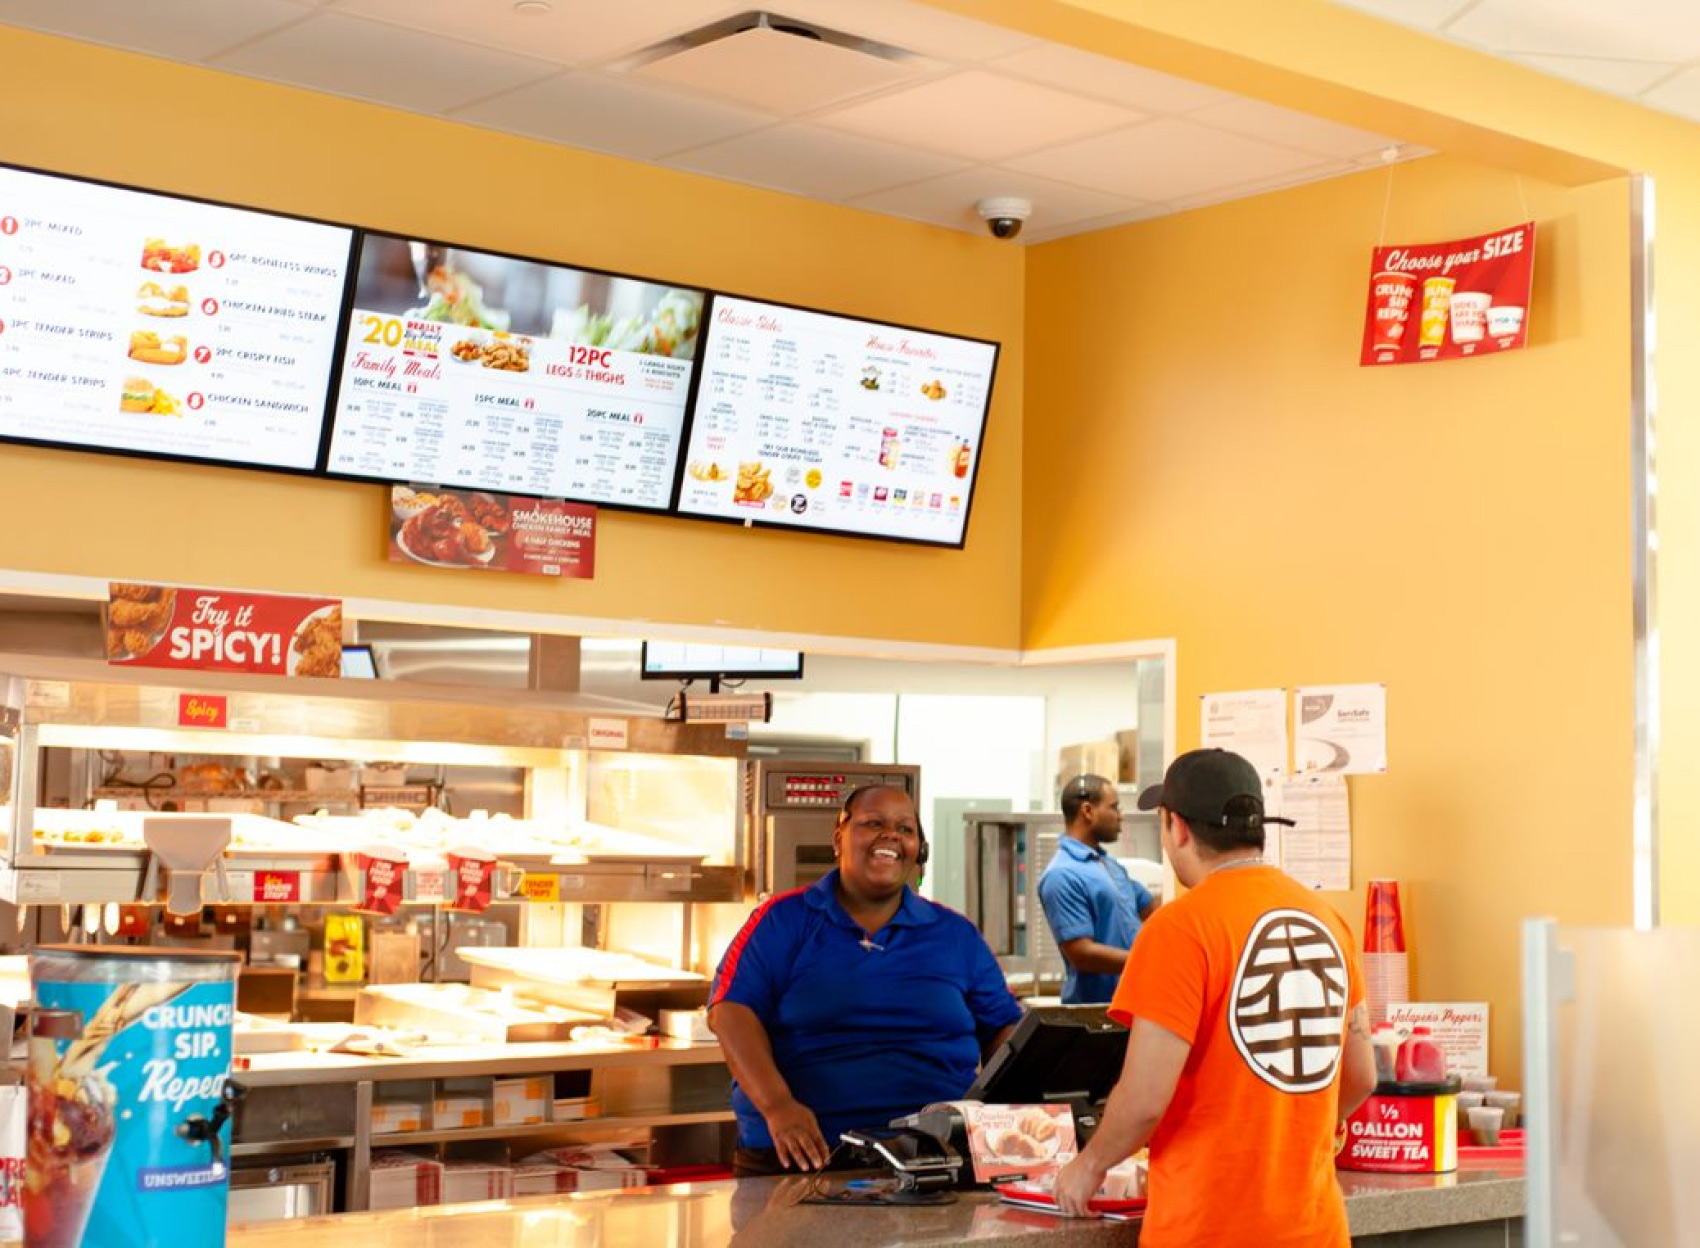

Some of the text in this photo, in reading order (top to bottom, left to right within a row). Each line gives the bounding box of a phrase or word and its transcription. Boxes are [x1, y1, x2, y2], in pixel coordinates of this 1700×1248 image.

[48, 221, 83, 236] MIXED
[1385, 230, 1525, 276] Choose your SIZE
[41, 270, 77, 285] MIXED
[303, 264, 338, 278] WINGS
[222, 299, 266, 314] CHICKEN
[34, 321, 75, 335] TENDER
[79, 328, 114, 341] STRIPS
[407, 321, 442, 332] REALLY
[404, 339, 439, 353] MEAL
[236, 352, 272, 364] CRISPY
[569, 345, 612, 368] 12PC
[352, 352, 442, 381] Family Meals
[546, 363, 573, 378] LEGS
[585, 369, 626, 386] THIGHS
[27, 369, 68, 383] TENDER
[72, 375, 106, 388] STRIPS
[377, 380, 402, 392] MEAL
[207, 393, 252, 407] CHICKEN
[254, 399, 310, 414] SANDWICH
[497, 397, 520, 408] MEAL
[608, 411, 631, 423] MEAL
[513, 508, 593, 530] SMOKEHOUSE
[192, 595, 255, 633] Try it
[169, 626, 281, 666] SPICY!
[186, 697, 218, 722] Spicy
[1442, 1008, 1484, 1026] Peppers
[175, 1032, 221, 1060] SIP.
[1351, 1121, 1423, 1138] GALLON
[1351, 1145, 1429, 1160] SWEET TEA
